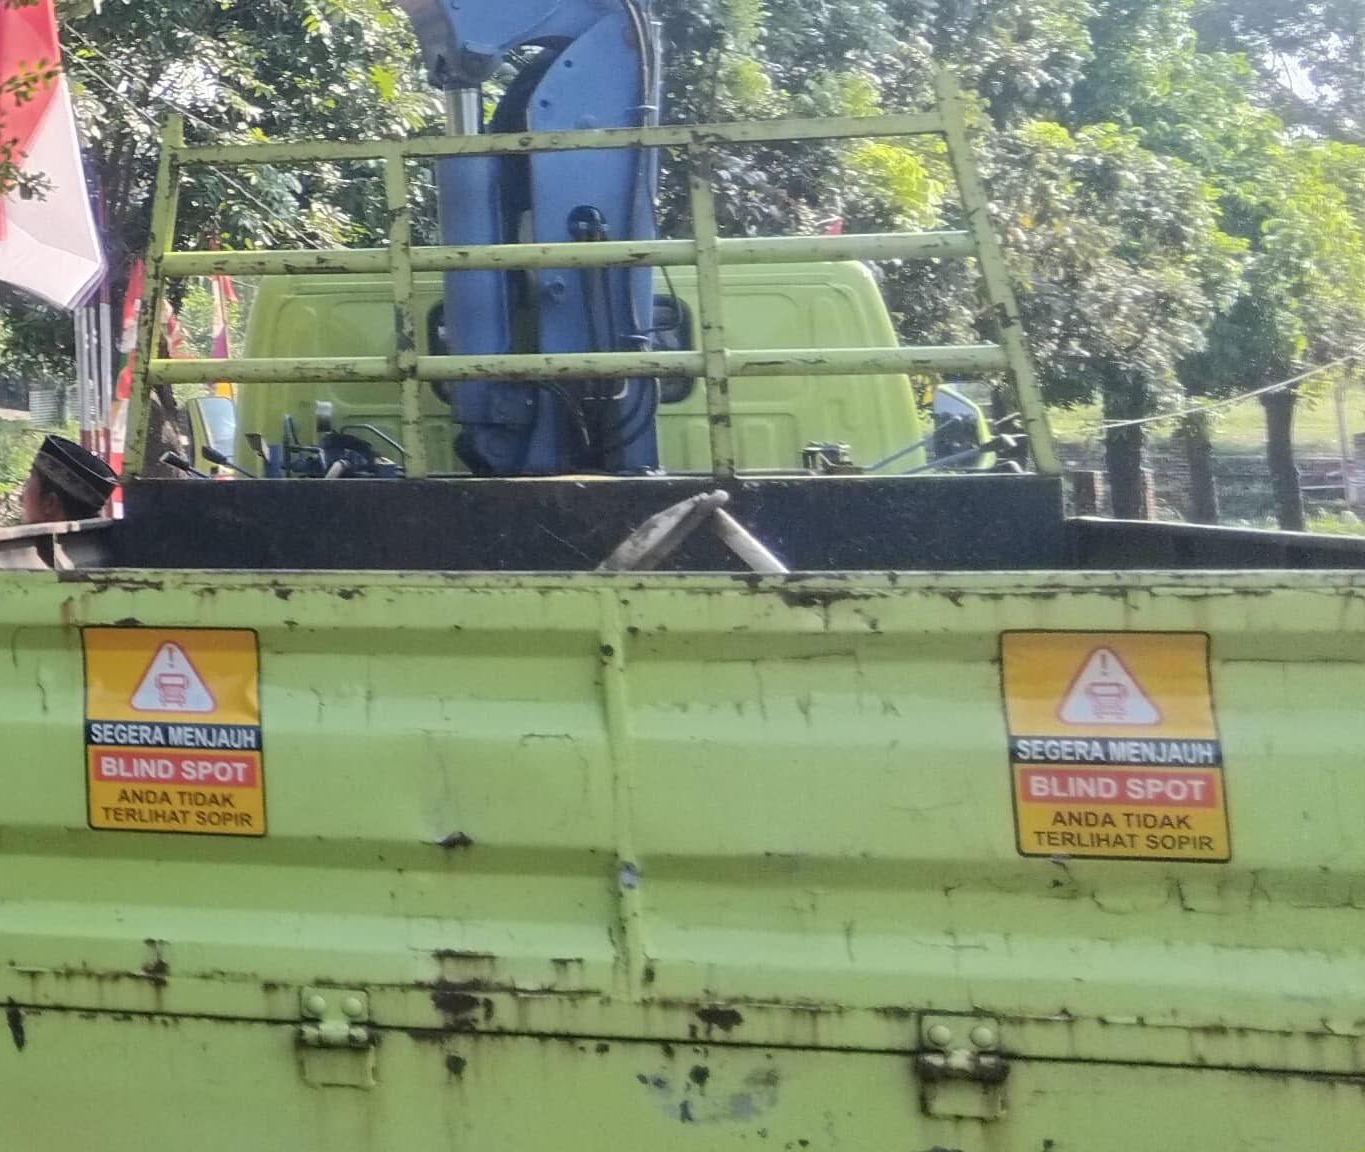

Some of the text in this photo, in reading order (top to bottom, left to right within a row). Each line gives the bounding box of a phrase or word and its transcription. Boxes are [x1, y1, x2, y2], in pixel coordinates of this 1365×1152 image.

[91, 723, 256, 749] SEGERA MENJAUH
[1016, 740, 1214, 764] SEGERA MENJAUH
[100, 756, 248, 782] BLIND SPOT
[118, 788, 235, 808] ANDA TIDAK
[1029, 775, 1205, 801] BLIND SPOT
[102, 807, 252, 827] TERLIHAT SOPIR
[1052, 811, 1191, 829] ANDA TIDAK
[1033, 830, 1214, 851] TERLIHAT SOPIR
